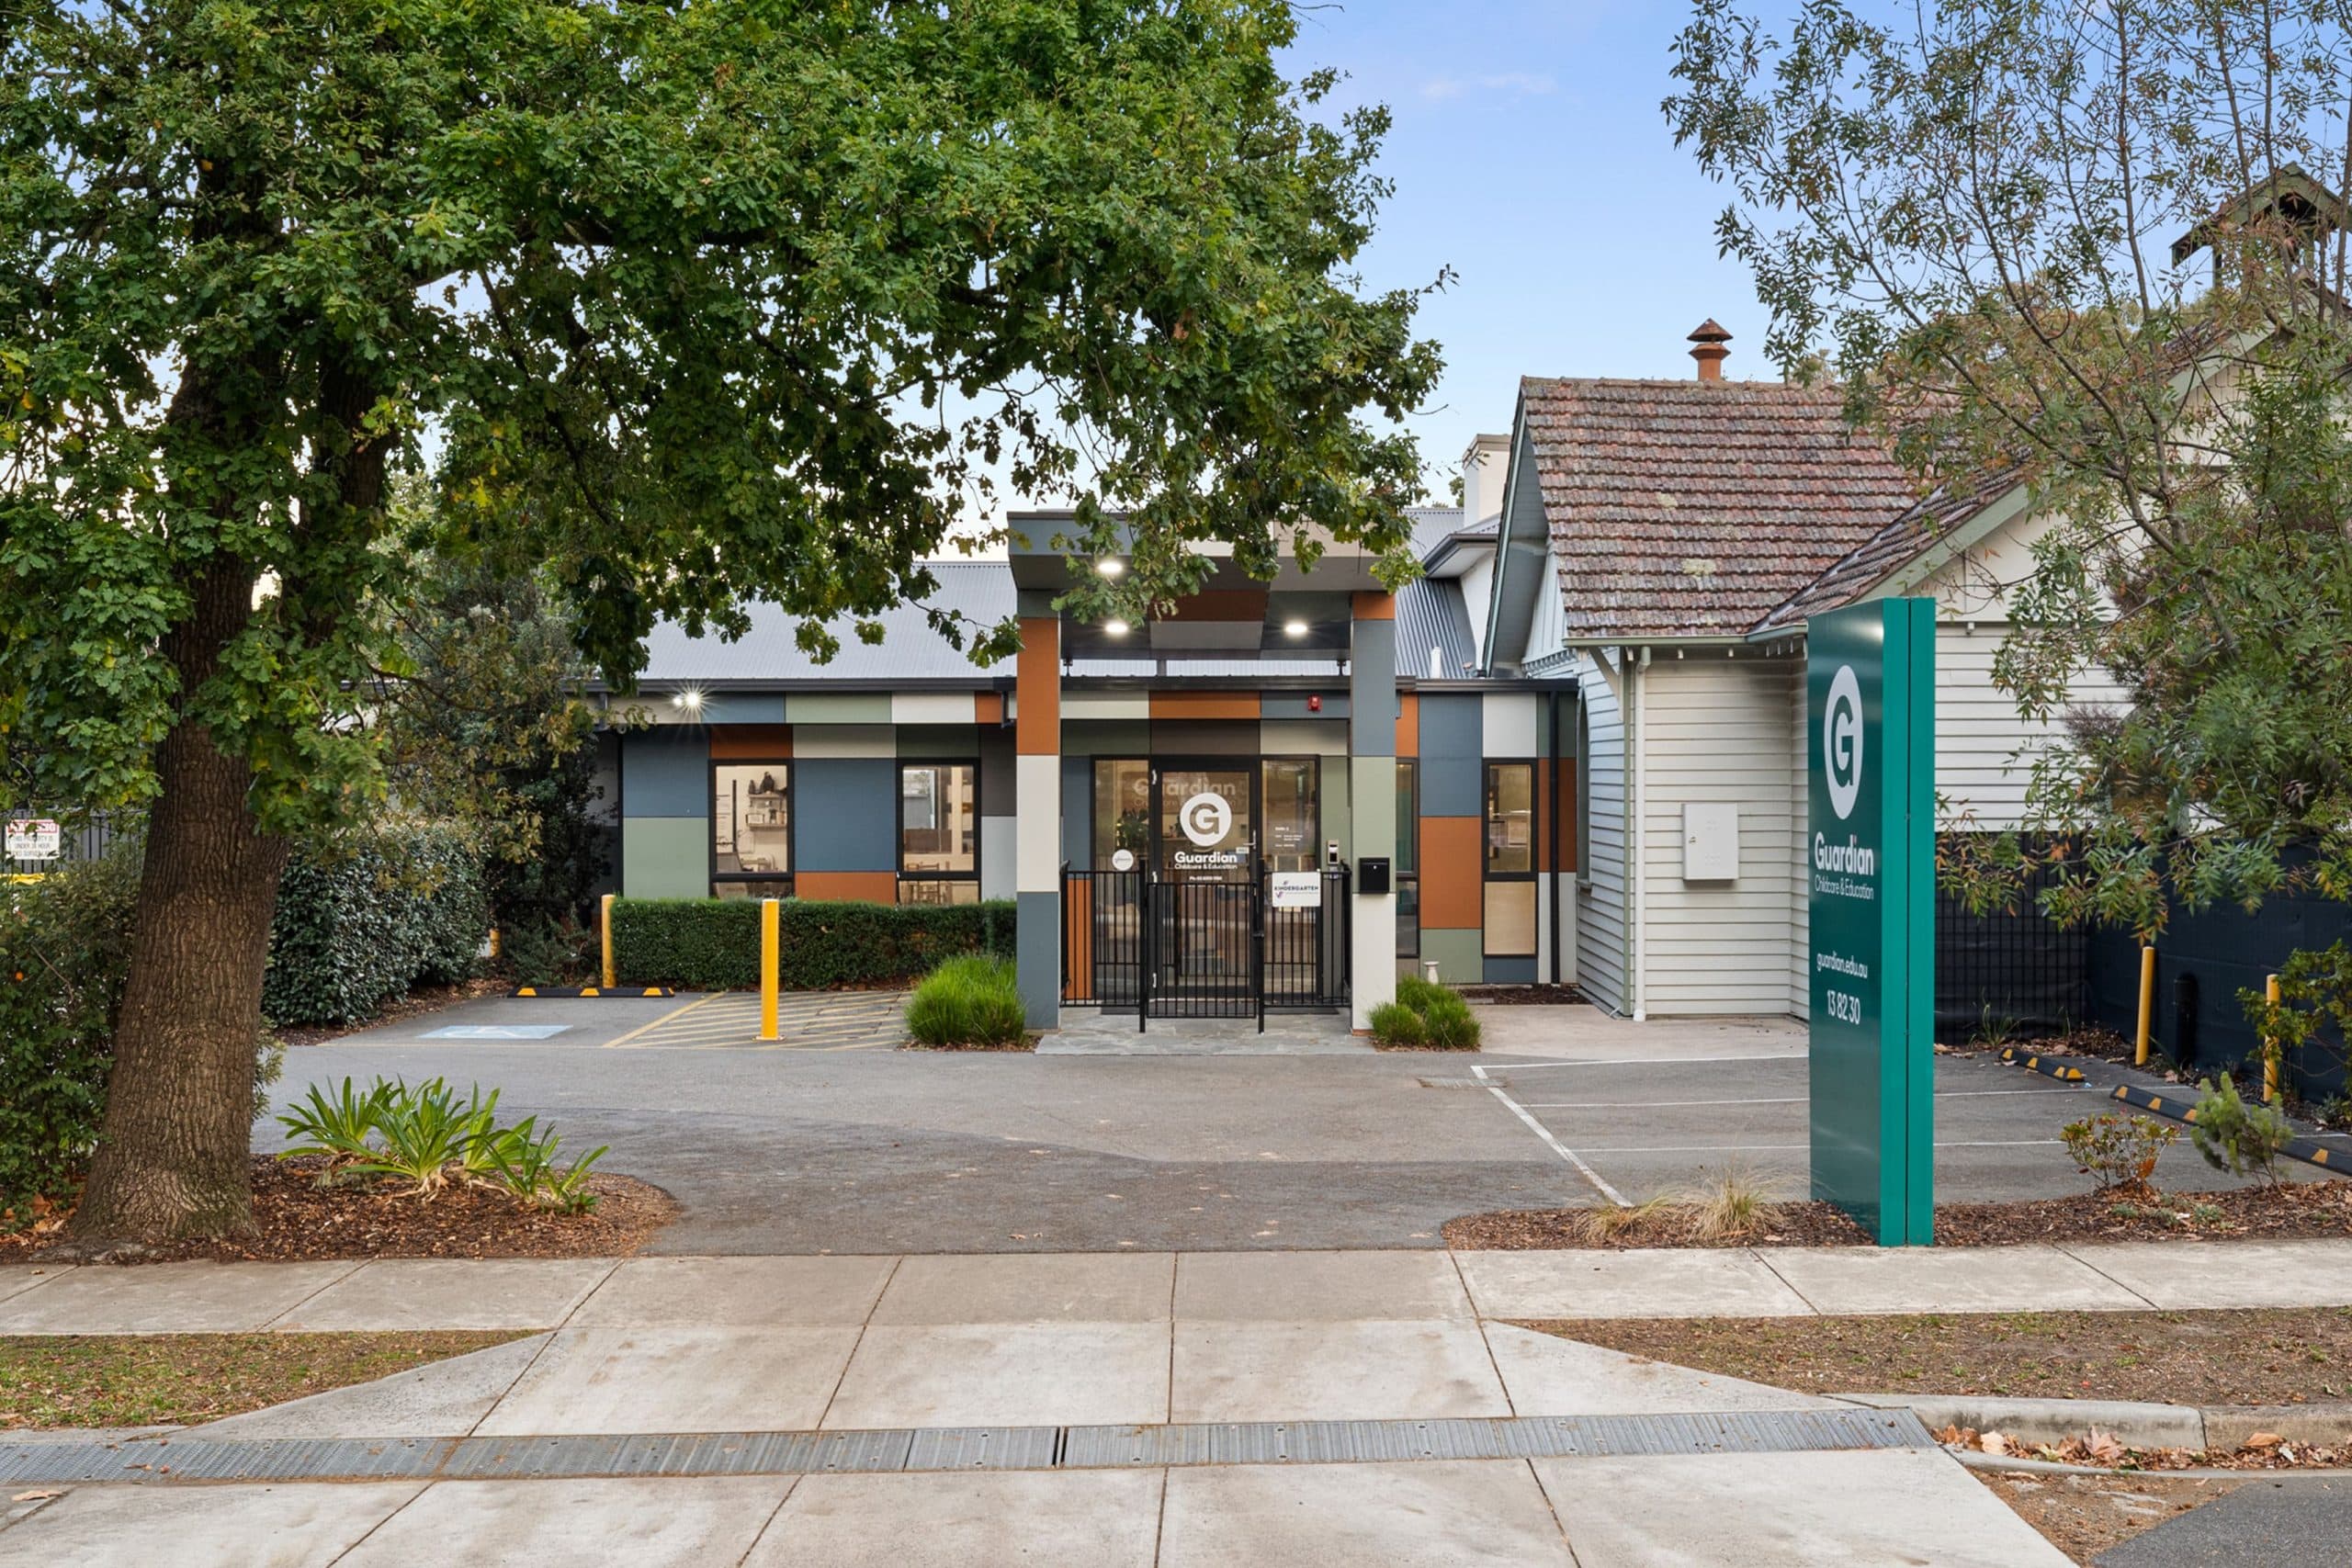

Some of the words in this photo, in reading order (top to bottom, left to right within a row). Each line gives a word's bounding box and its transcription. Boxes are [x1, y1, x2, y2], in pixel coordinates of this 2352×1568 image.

[1830, 694, 1854, 787] G
[1190, 802, 1219, 834] G
[1174, 851, 1238, 863] Guardian
[1815, 831, 1874, 876] Guardian
[1815, 874, 1839, 896] Childcare
[1840, 877, 1845, 896] &
[1845, 878, 1874, 900] Education
[1816, 950, 1868, 979] guardian.edu.au
[1827, 989, 1836, 1017] 13
[1838, 992, 1848, 1021] 82
[1849, 996, 1860, 1024] 30
